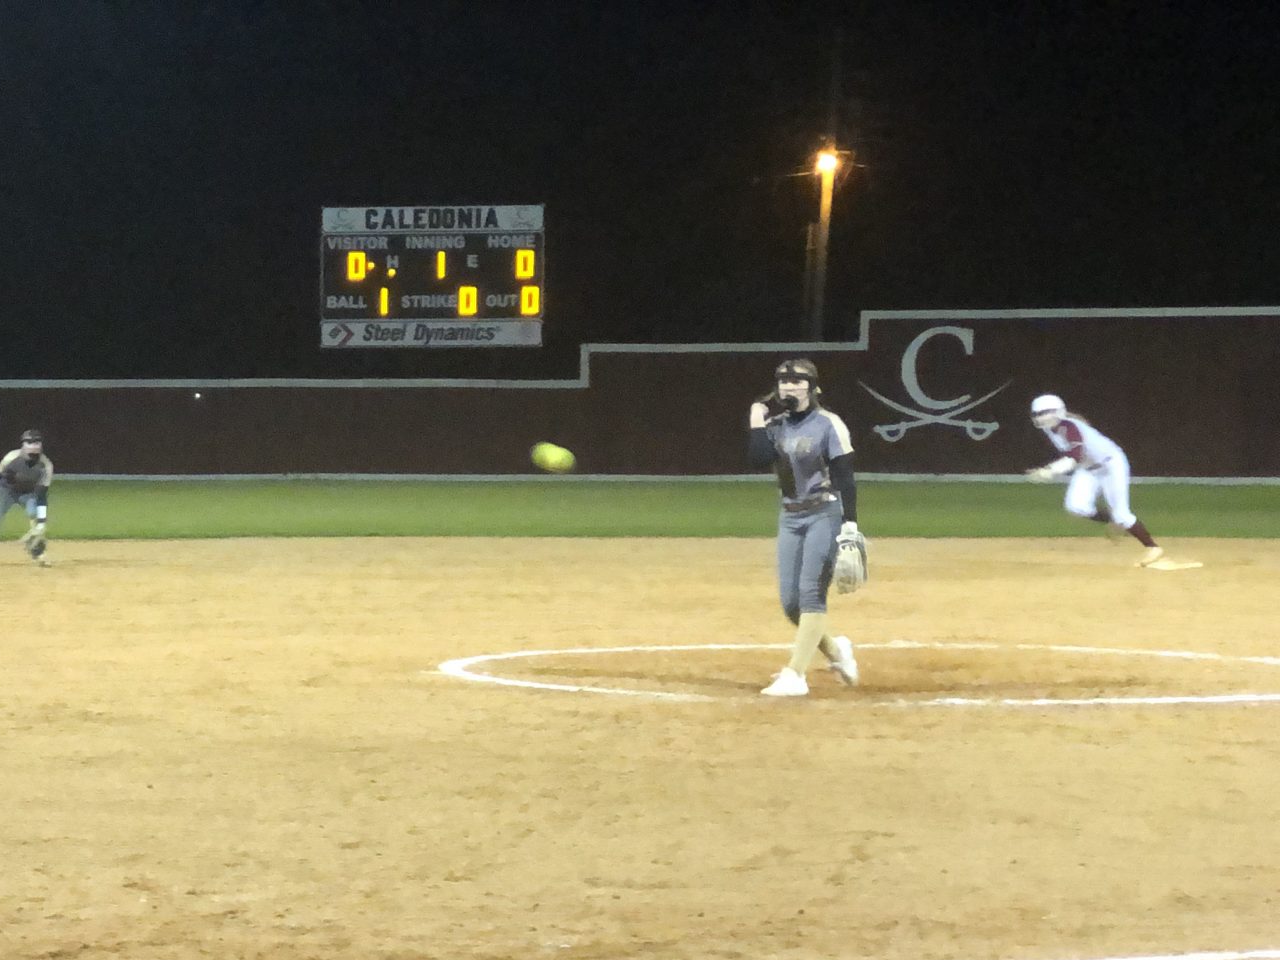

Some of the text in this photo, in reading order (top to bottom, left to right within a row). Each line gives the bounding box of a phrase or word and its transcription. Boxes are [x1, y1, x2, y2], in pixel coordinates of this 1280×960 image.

[365, 208, 498, 229] CALEDONIA
[327, 237, 388, 250] VISITOR
[406, 236, 465, 249] INNING
[487, 236, 536, 248] HOME
[467, 254, 479, 268] E
[326, 296, 367, 309] BALL
[485, 294, 519, 308] OUT
[362, 323, 407, 341] Steel
[413, 324, 496, 344] Dynamics
[901, 325, 974, 410] C
